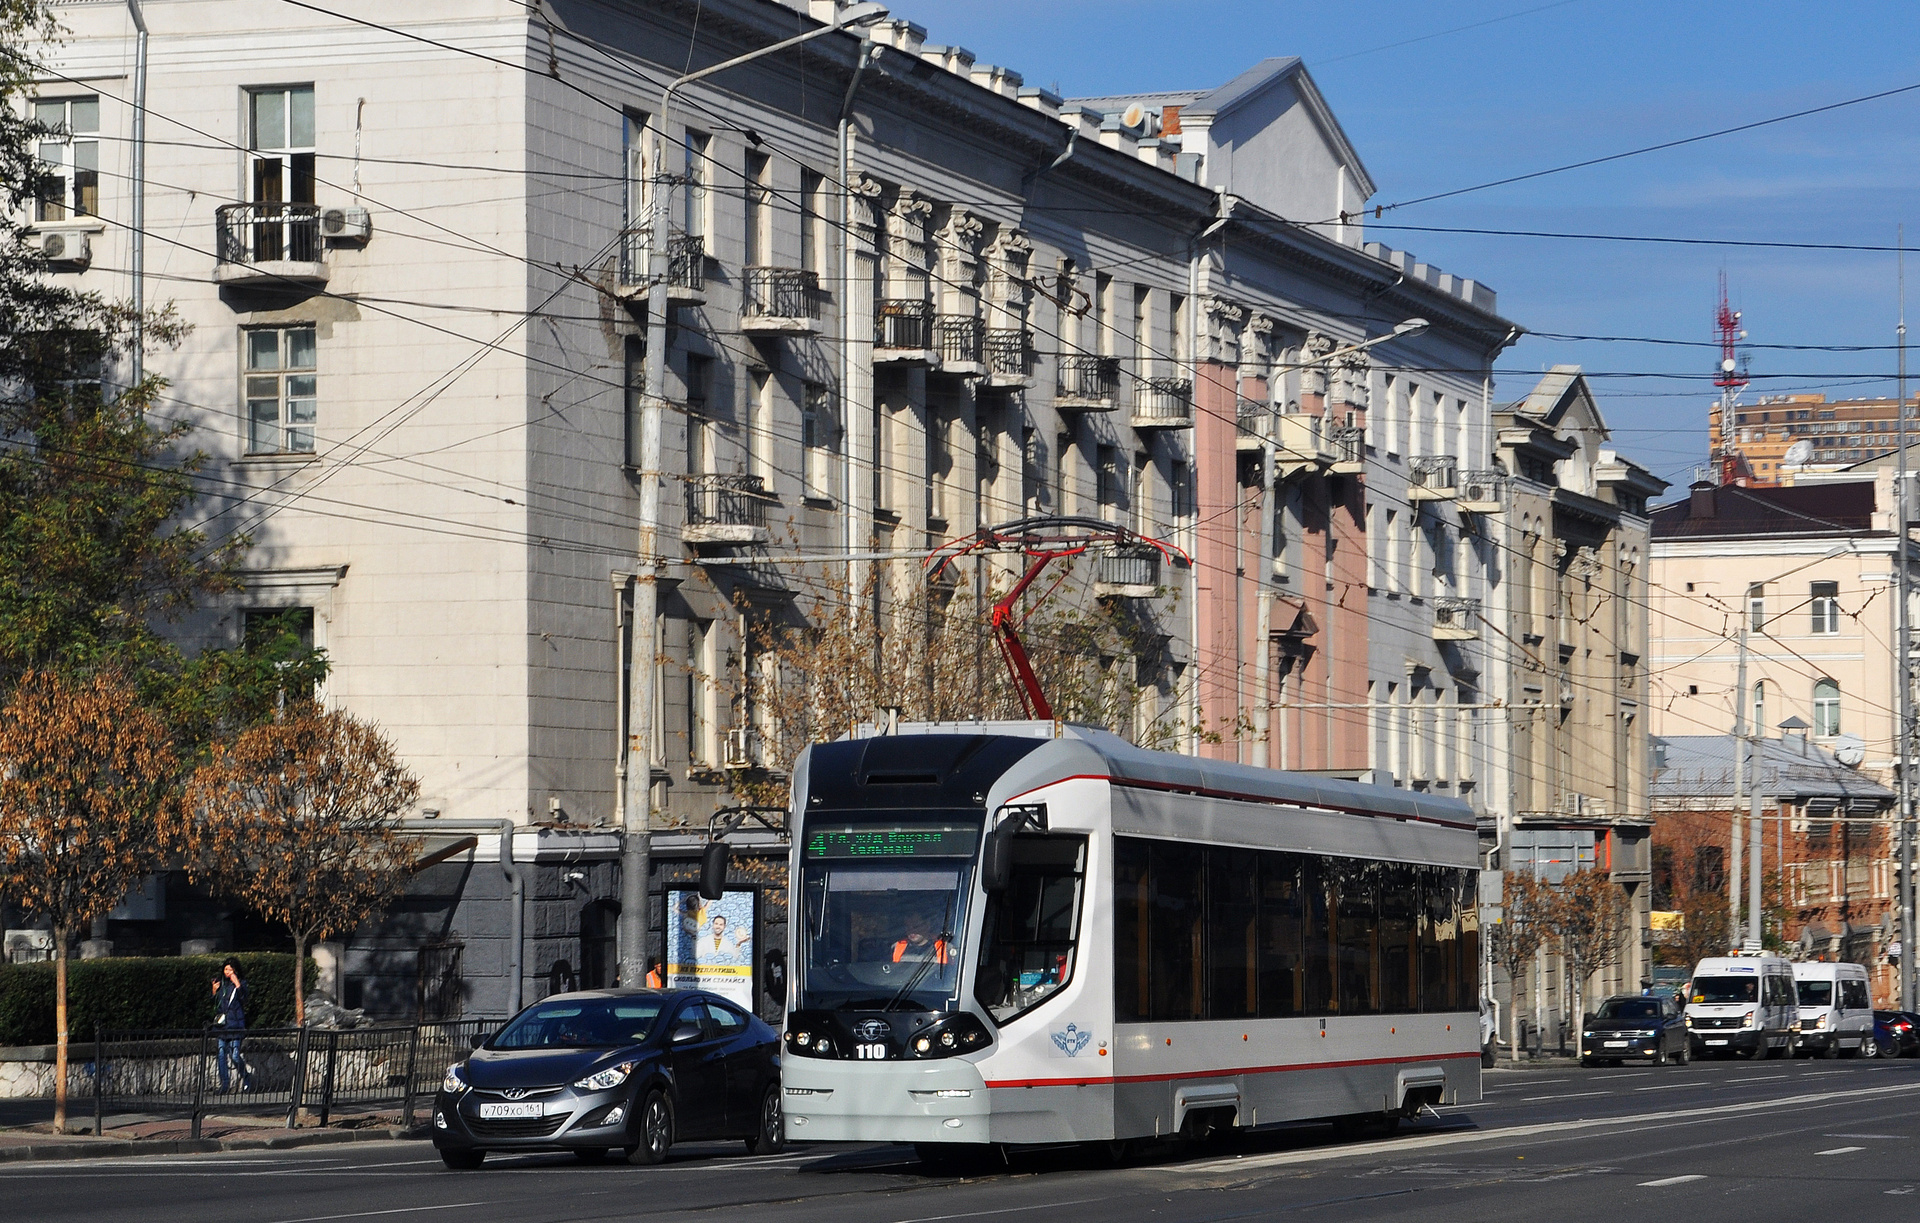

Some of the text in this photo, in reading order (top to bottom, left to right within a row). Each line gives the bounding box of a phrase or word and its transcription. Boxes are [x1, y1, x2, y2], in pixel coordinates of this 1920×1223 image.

[888, 832, 942, 843] Вокзал
[808, 833, 827, 856] 4
[850, 844, 914, 855] Сельмаш
[856, 1043, 886, 1059] 110
